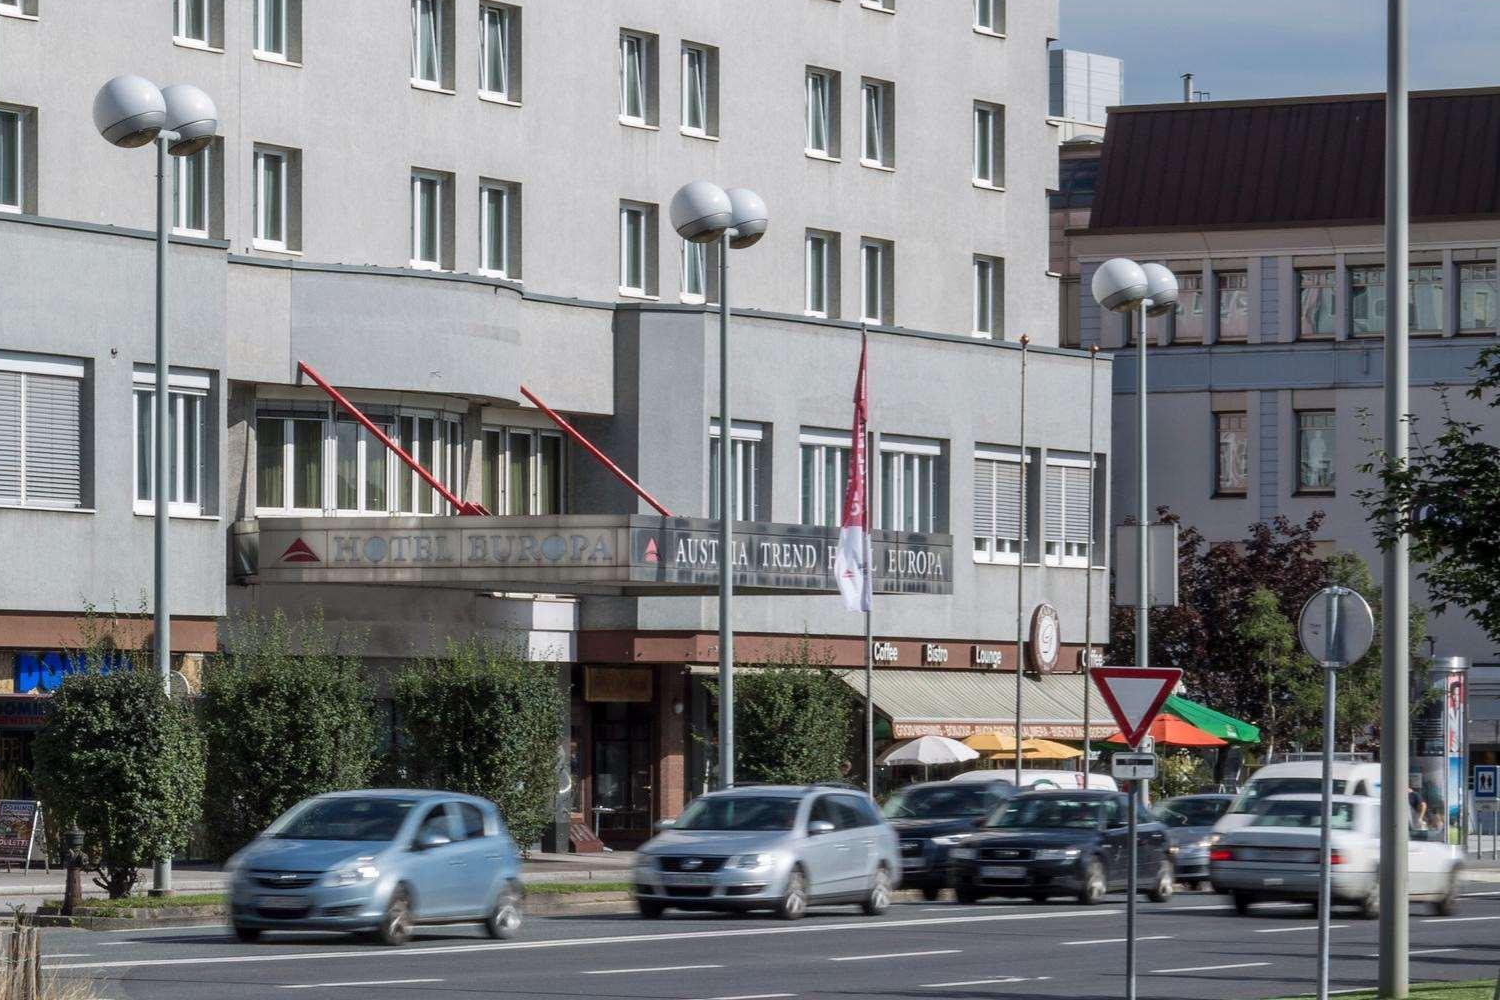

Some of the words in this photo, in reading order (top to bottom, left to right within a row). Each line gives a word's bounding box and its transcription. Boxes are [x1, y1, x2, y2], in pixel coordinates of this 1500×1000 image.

[333, 536, 453, 562] HOTEL
[468, 535, 613, 561] EUROPA
[676, 538, 748, 566] AUSTIA
[761, 542, 817, 568] TREND
[888, 549, 943, 575] EUROPA
[874, 643, 898, 661] Coffee
[927, 644, 948, 662] Bistro
[976, 646, 1002, 668] Lounge
[1081, 648, 1104, 667] Cffee
